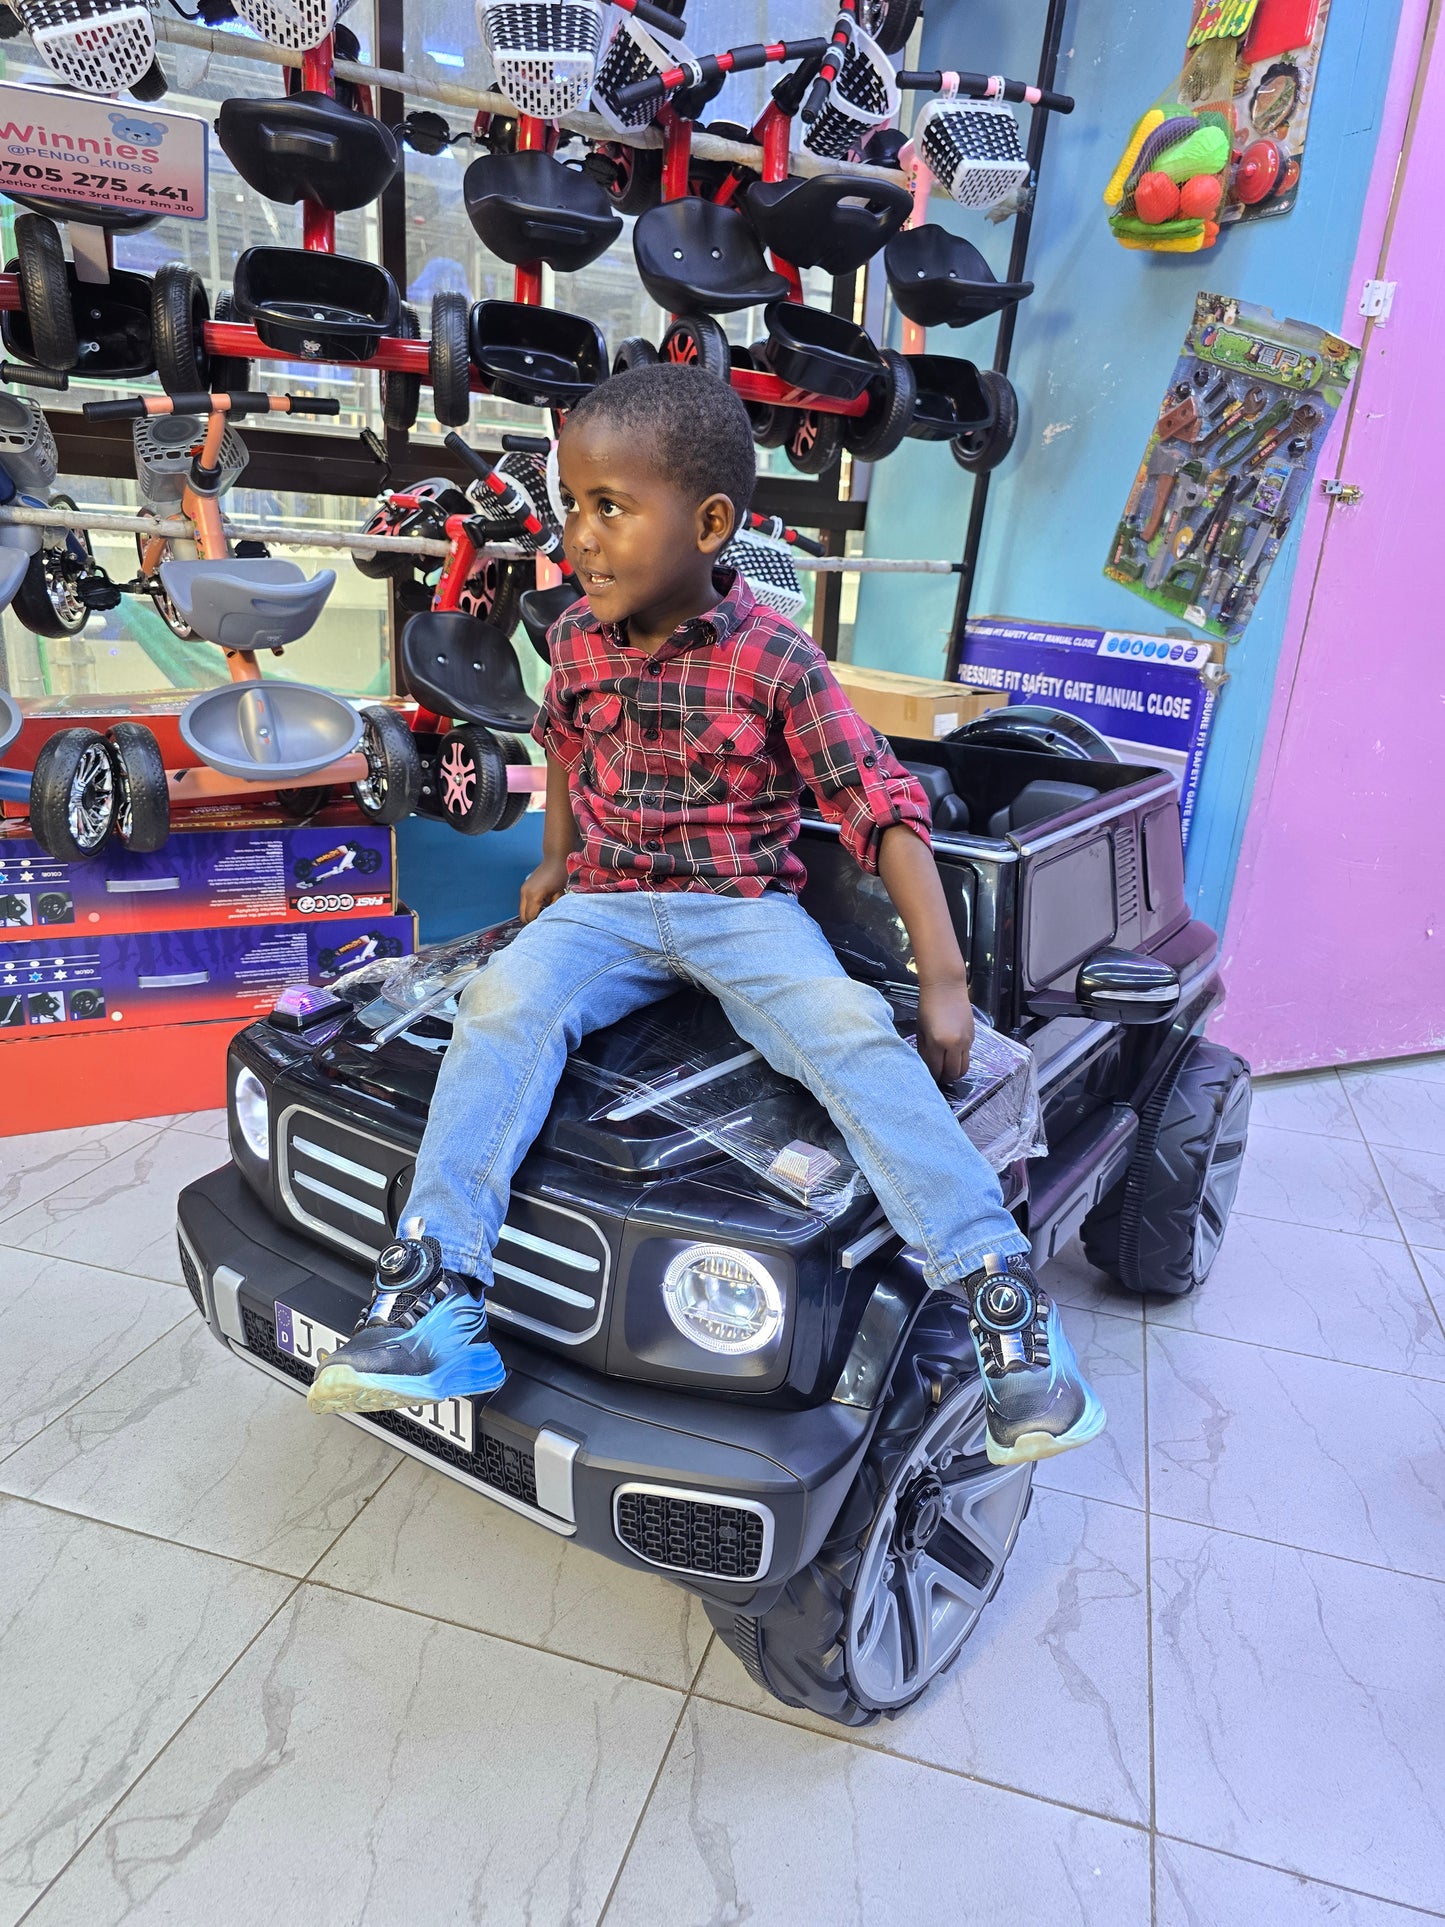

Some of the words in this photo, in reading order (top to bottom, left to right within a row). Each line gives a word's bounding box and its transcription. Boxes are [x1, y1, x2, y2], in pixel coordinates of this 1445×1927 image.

[0, 122, 160, 164] Winnies
[8, 144, 153, 174] @PENDO_KIDSS
[0, 161, 63, 182] 705
[72, 171, 128, 192] 275
[137, 182, 188, 202] 441
[41, 184, 85, 196] Centre
[89, 190, 110, 200] 3rd
[114, 194, 147, 205] Floor
[150, 200, 171, 209] Rm
[1072, 637, 1099, 648] CLOSE
[1004, 670, 1022, 691] FIT
[1021, 673, 1064, 698] SAFETY
[1064, 680, 1094, 704] GATE
[1095, 685, 1145, 712] MANUAL
[1147, 693, 1192, 720] CLOSE
[1196, 731, 1207, 748] FIT
[1189, 750, 1204, 788] SAFETY
[1183, 790, 1196, 816] GATE
[355, 896, 384, 906] FAST
[281, 1330, 289, 1343] D
[296, 1318, 314, 1358] J
